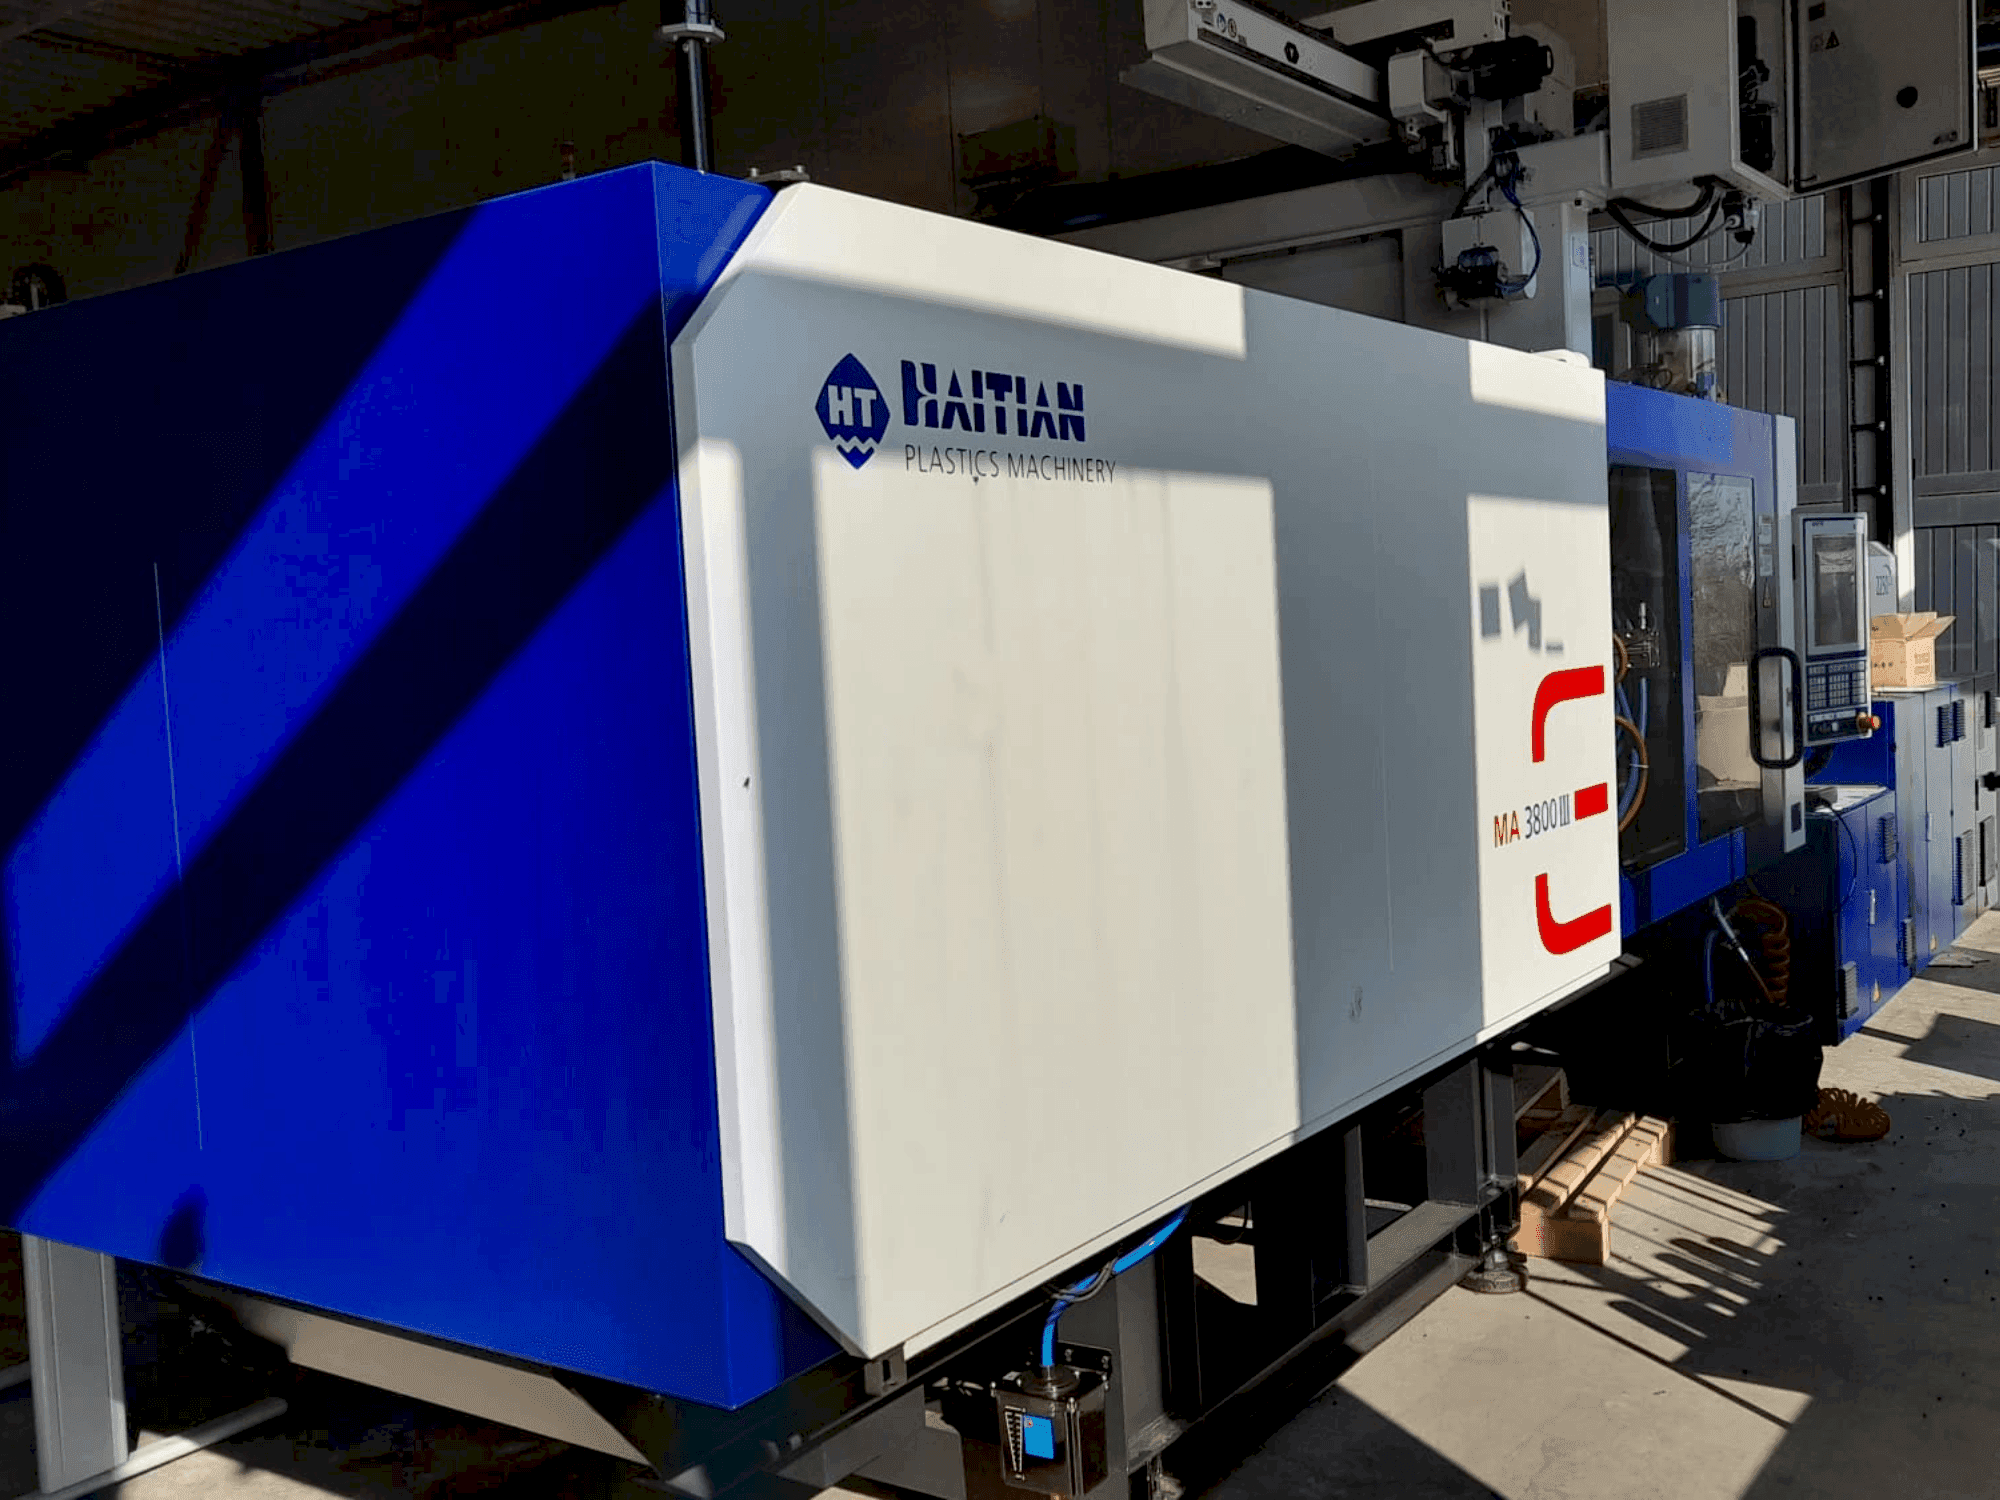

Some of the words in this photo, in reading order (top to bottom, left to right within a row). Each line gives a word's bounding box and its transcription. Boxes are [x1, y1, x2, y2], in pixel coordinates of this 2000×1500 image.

[900, 359, 1086, 442] HAITIAN
[904, 444, 1000, 478] PLASTICS
[1007, 452, 1117, 484] MACHINERY
[1494, 810, 1521, 849] MA
